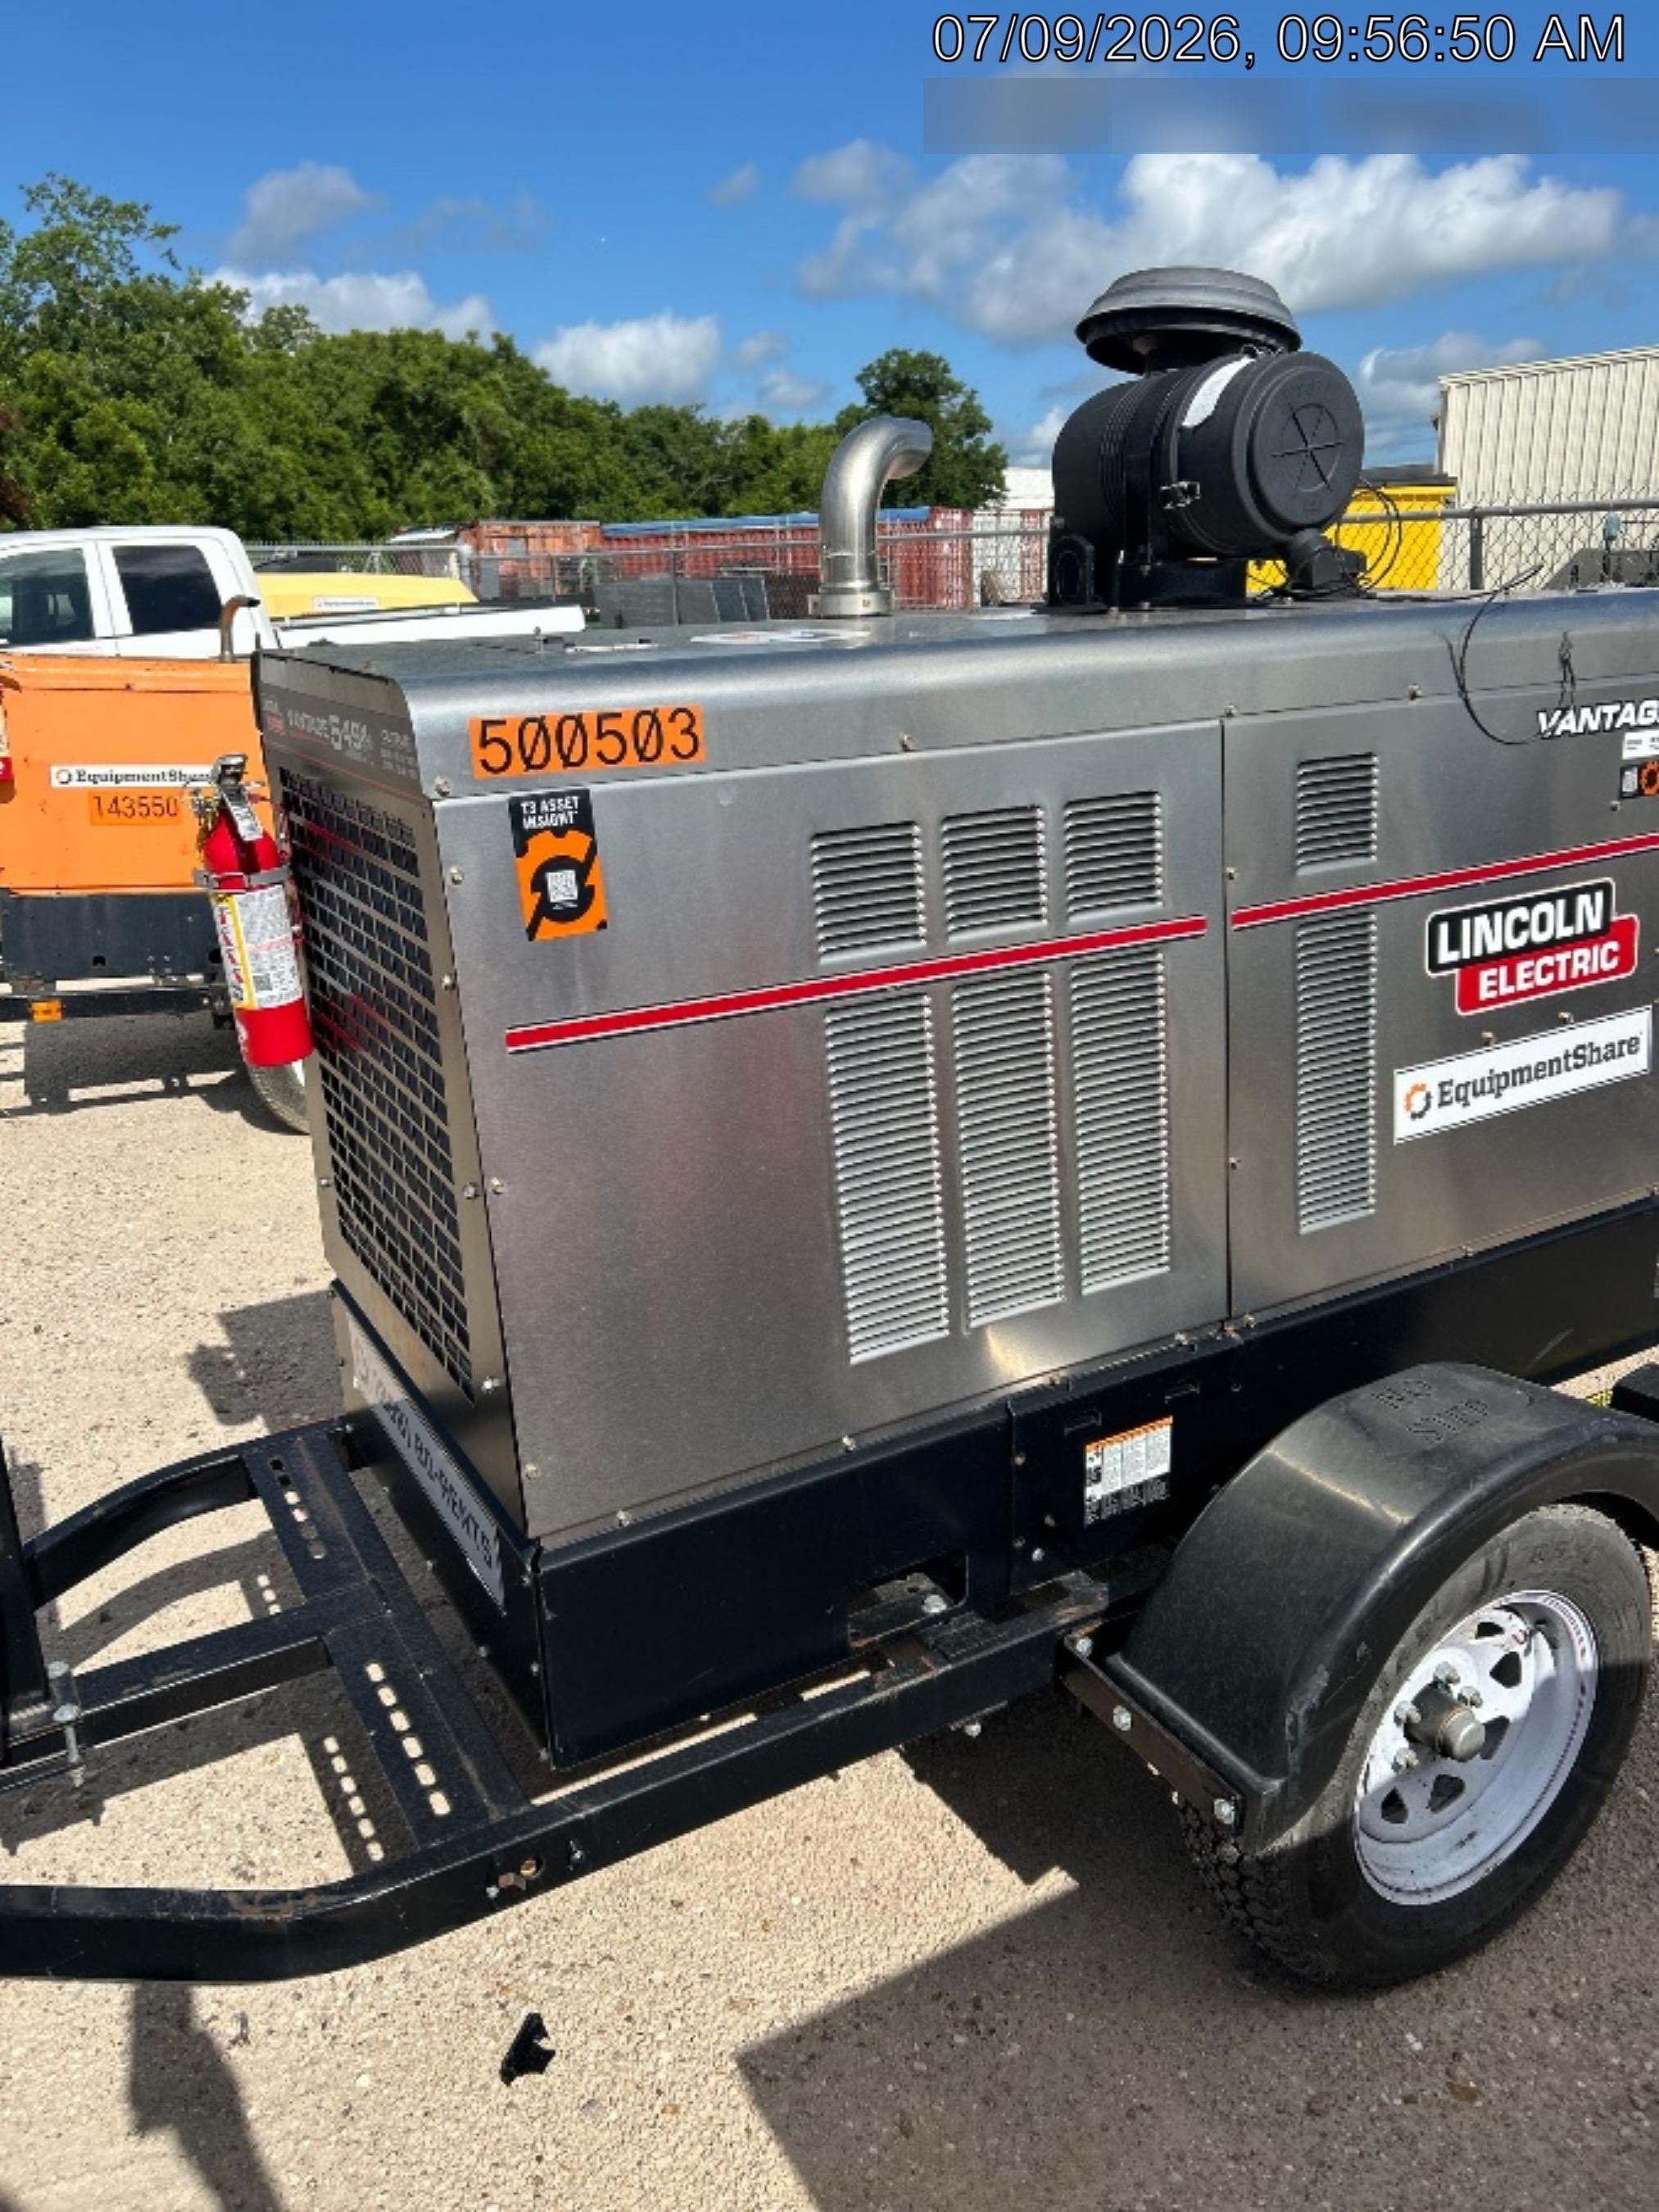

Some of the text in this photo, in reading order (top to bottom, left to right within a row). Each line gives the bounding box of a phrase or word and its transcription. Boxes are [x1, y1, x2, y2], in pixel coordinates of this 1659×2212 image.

[478, 707, 699, 774] 500503
[1537, 696, 1659, 739] VANTAG
[93, 795, 179, 819] 143550
[539, 796, 579, 814] ASSET
[1437, 890, 1604, 965] LINCOLN
[1479, 940, 1620, 1001] ELECTRIC
[1436, 1035, 1639, 1108] EquipmentShare
